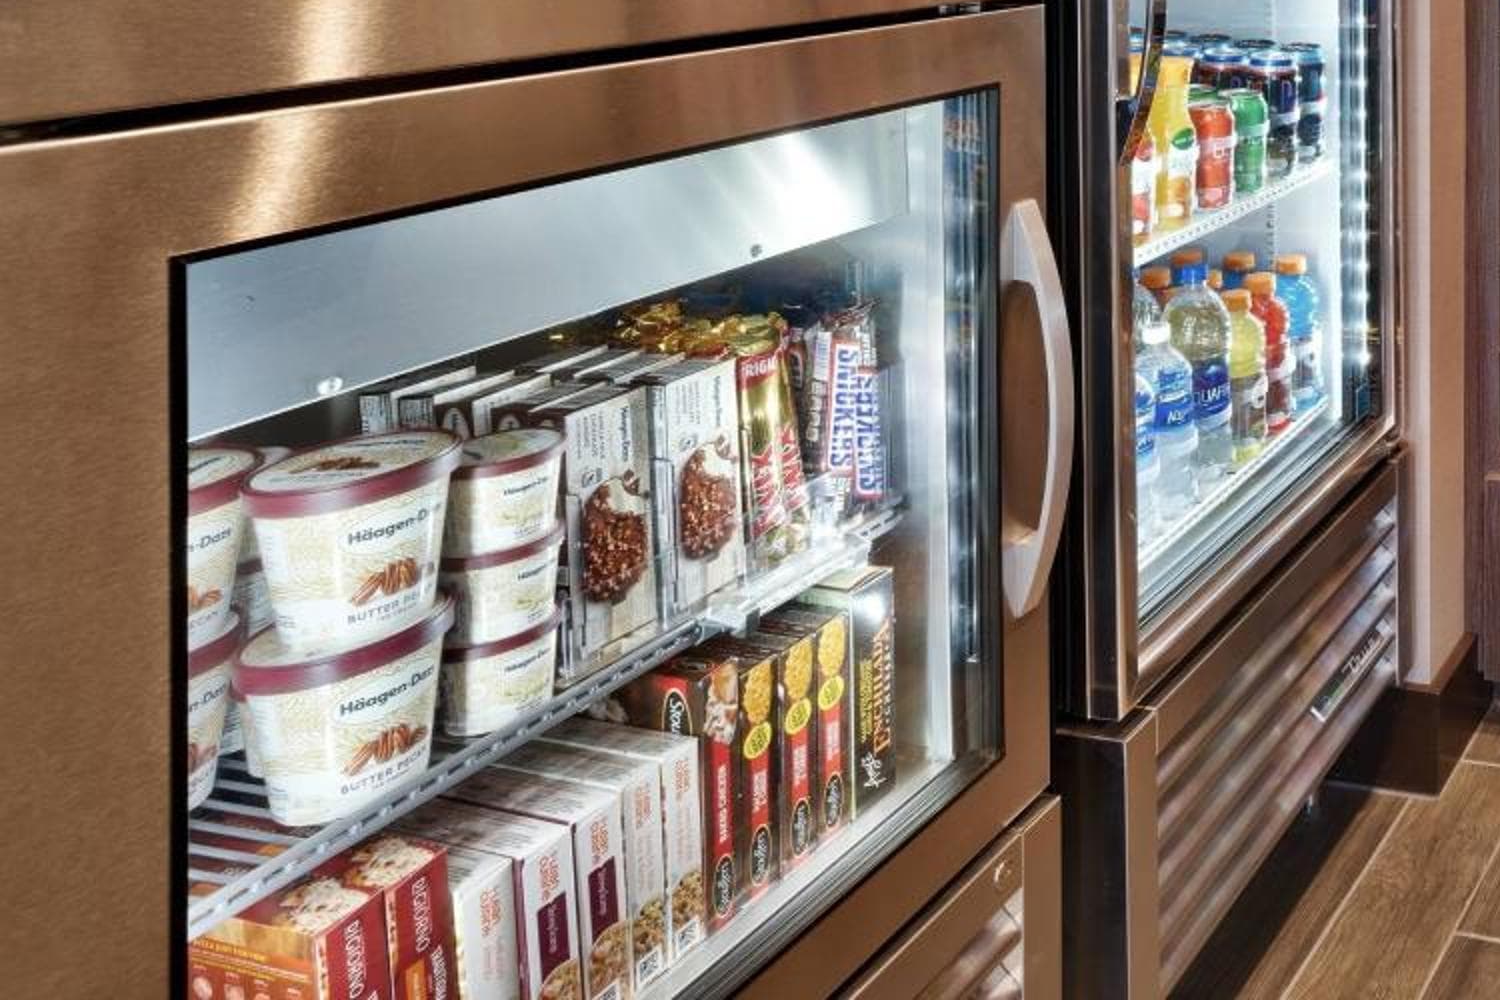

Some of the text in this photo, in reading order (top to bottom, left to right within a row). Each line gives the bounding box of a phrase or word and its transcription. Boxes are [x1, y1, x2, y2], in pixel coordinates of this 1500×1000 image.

[830, 348, 856, 468] SNICKERS
[347, 599, 400, 625] BUTTER
[872, 618, 891, 751] ENCHILADA
[340, 767, 394, 795] BUTTER
